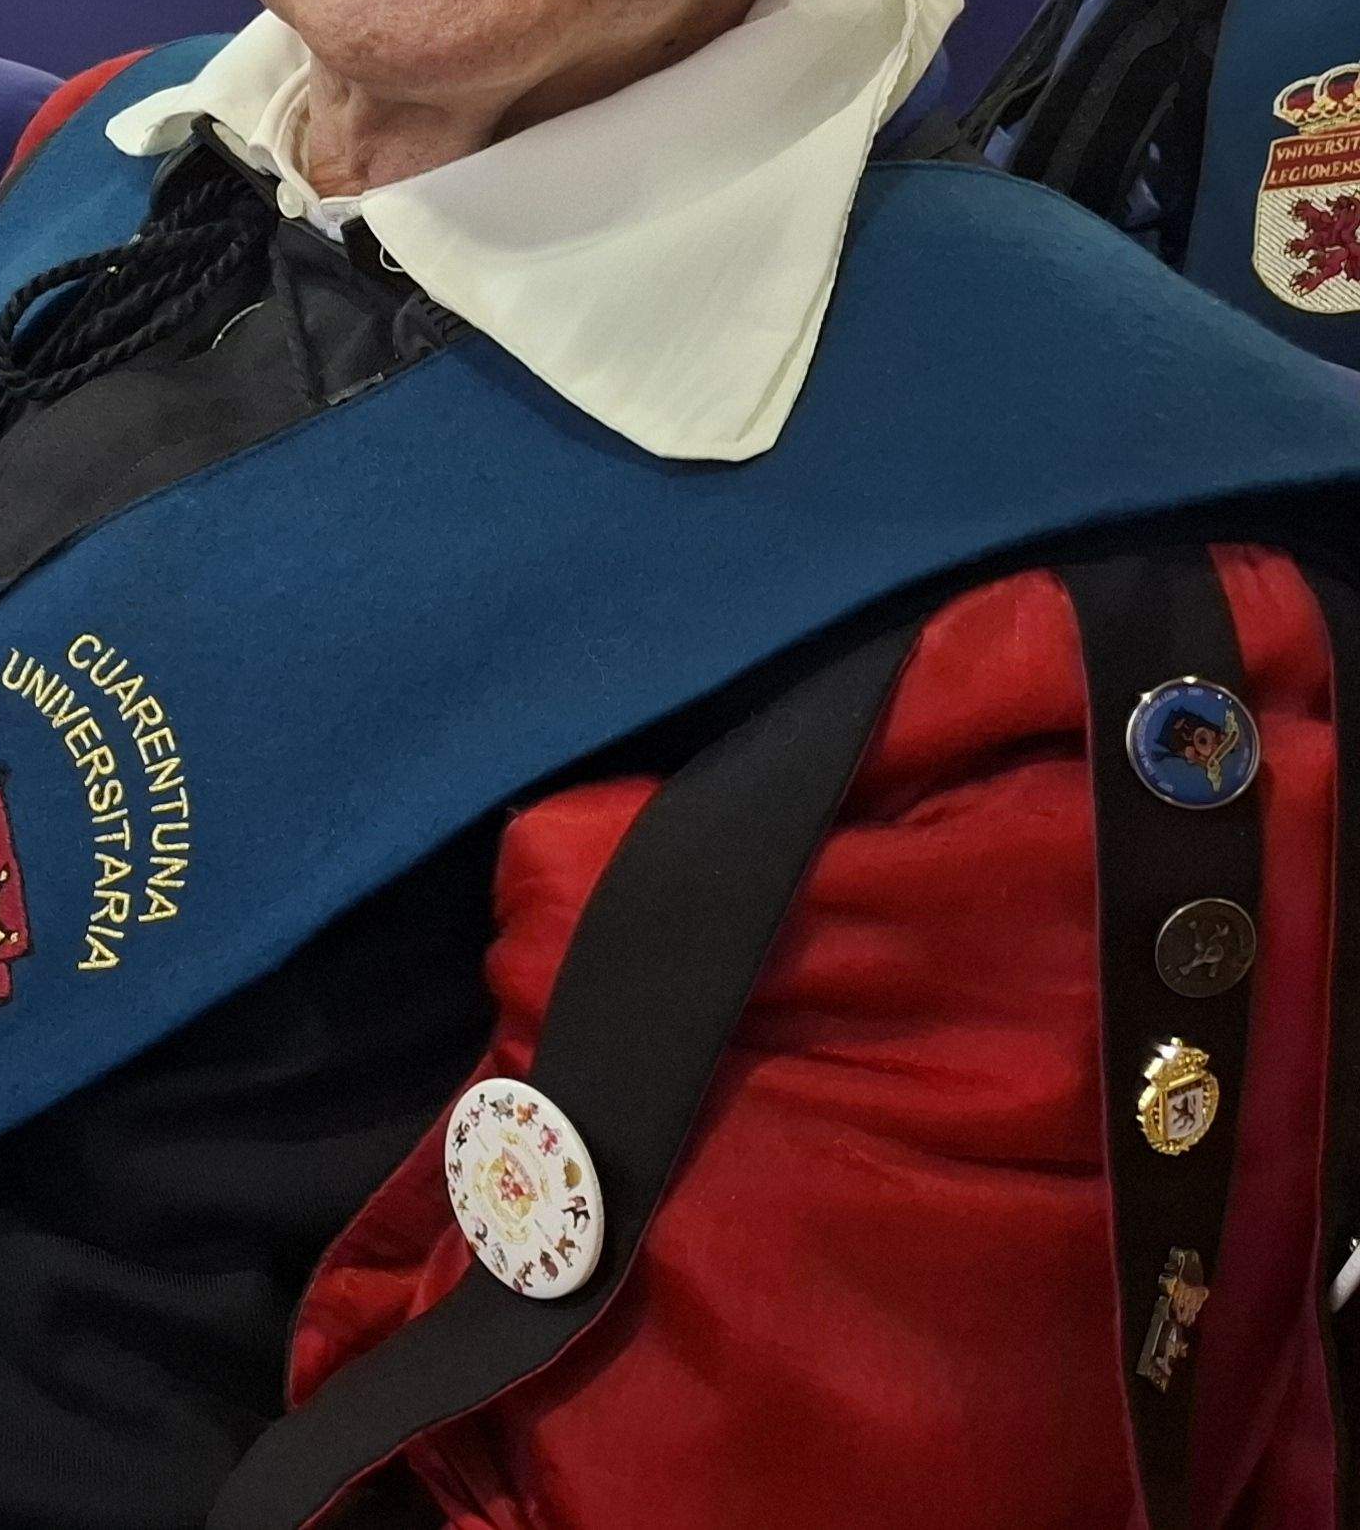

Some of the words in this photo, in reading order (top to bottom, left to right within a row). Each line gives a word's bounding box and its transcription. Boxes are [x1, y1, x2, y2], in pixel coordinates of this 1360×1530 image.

[1276, 135, 1360, 161] VNIVERSIT
[1, 647, 132, 970] UNIVERSITARIA
[68, 634, 190, 922] CUARENTUNA
